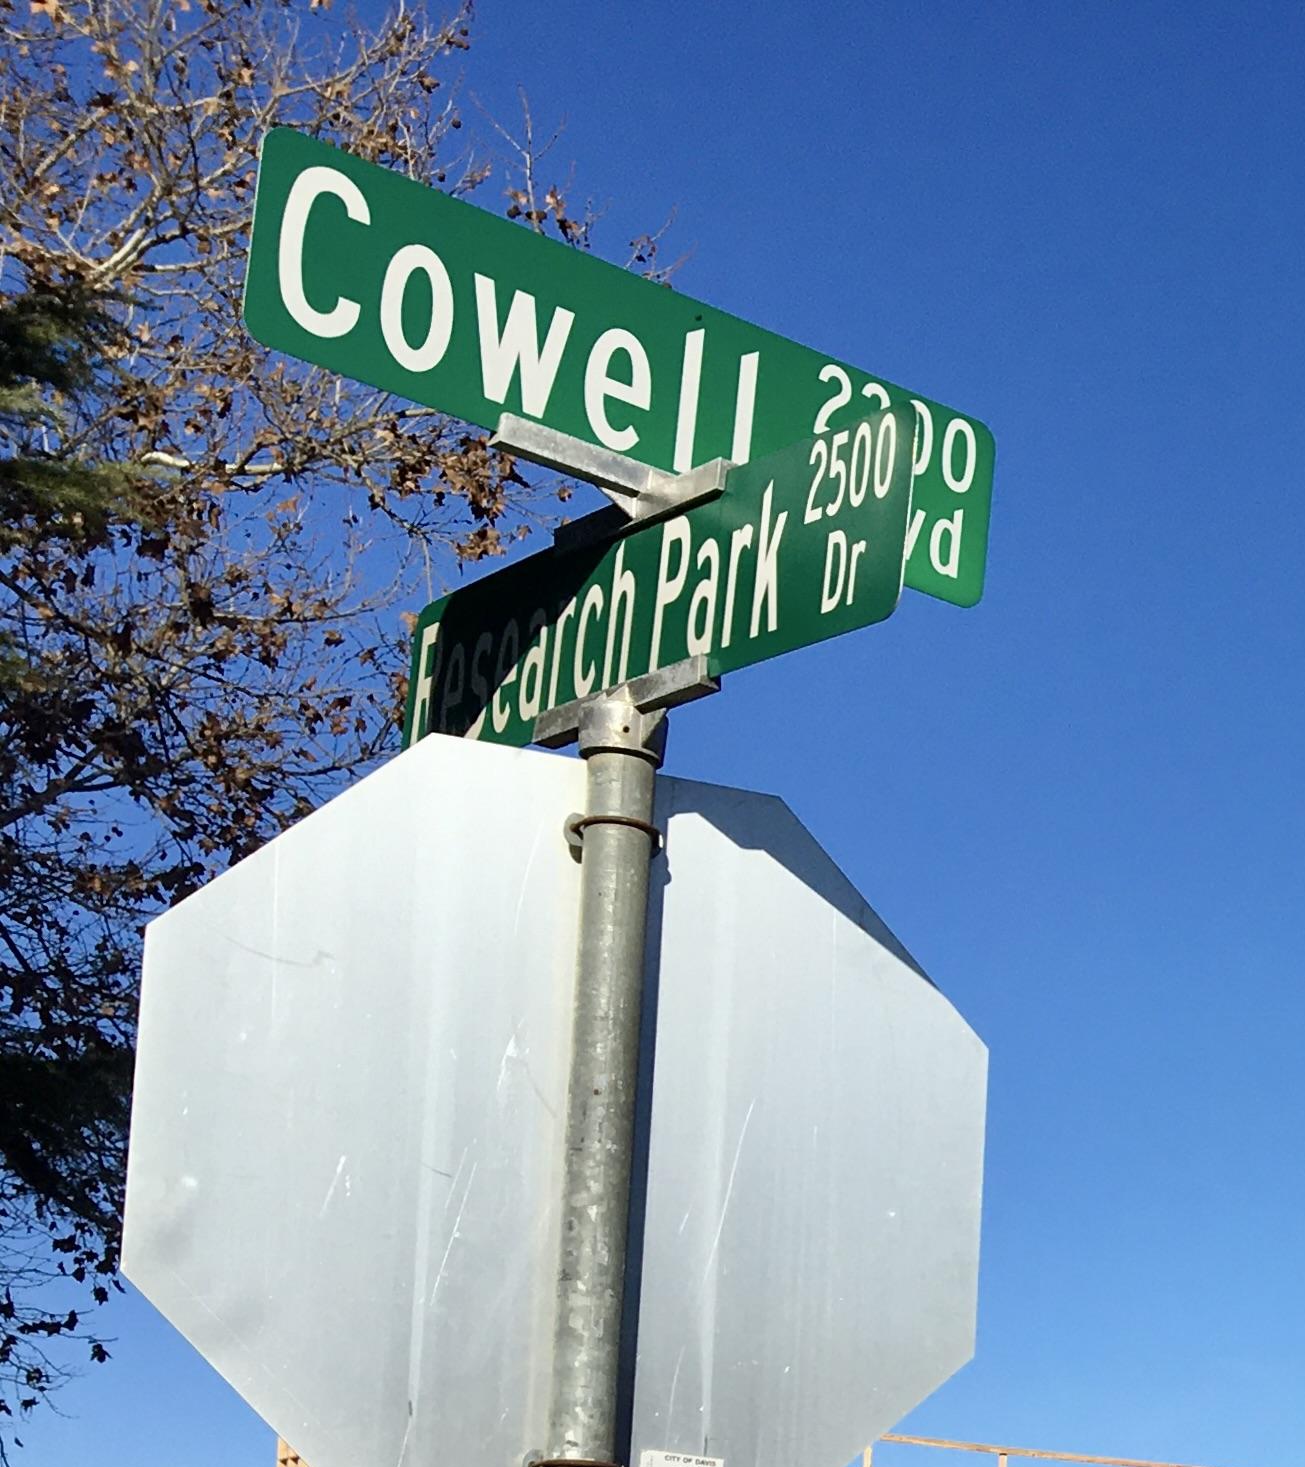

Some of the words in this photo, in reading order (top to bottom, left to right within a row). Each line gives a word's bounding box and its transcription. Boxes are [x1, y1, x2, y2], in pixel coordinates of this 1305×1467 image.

[278, 166, 759, 475] Cowell
[804, 412, 897, 525] 2500
[649, 480, 788, 673] Park
[820, 530, 867, 614] Dr
[664, 1454, 681, 1462] CITY
[695, 1458, 717, 1467] DAVIS
